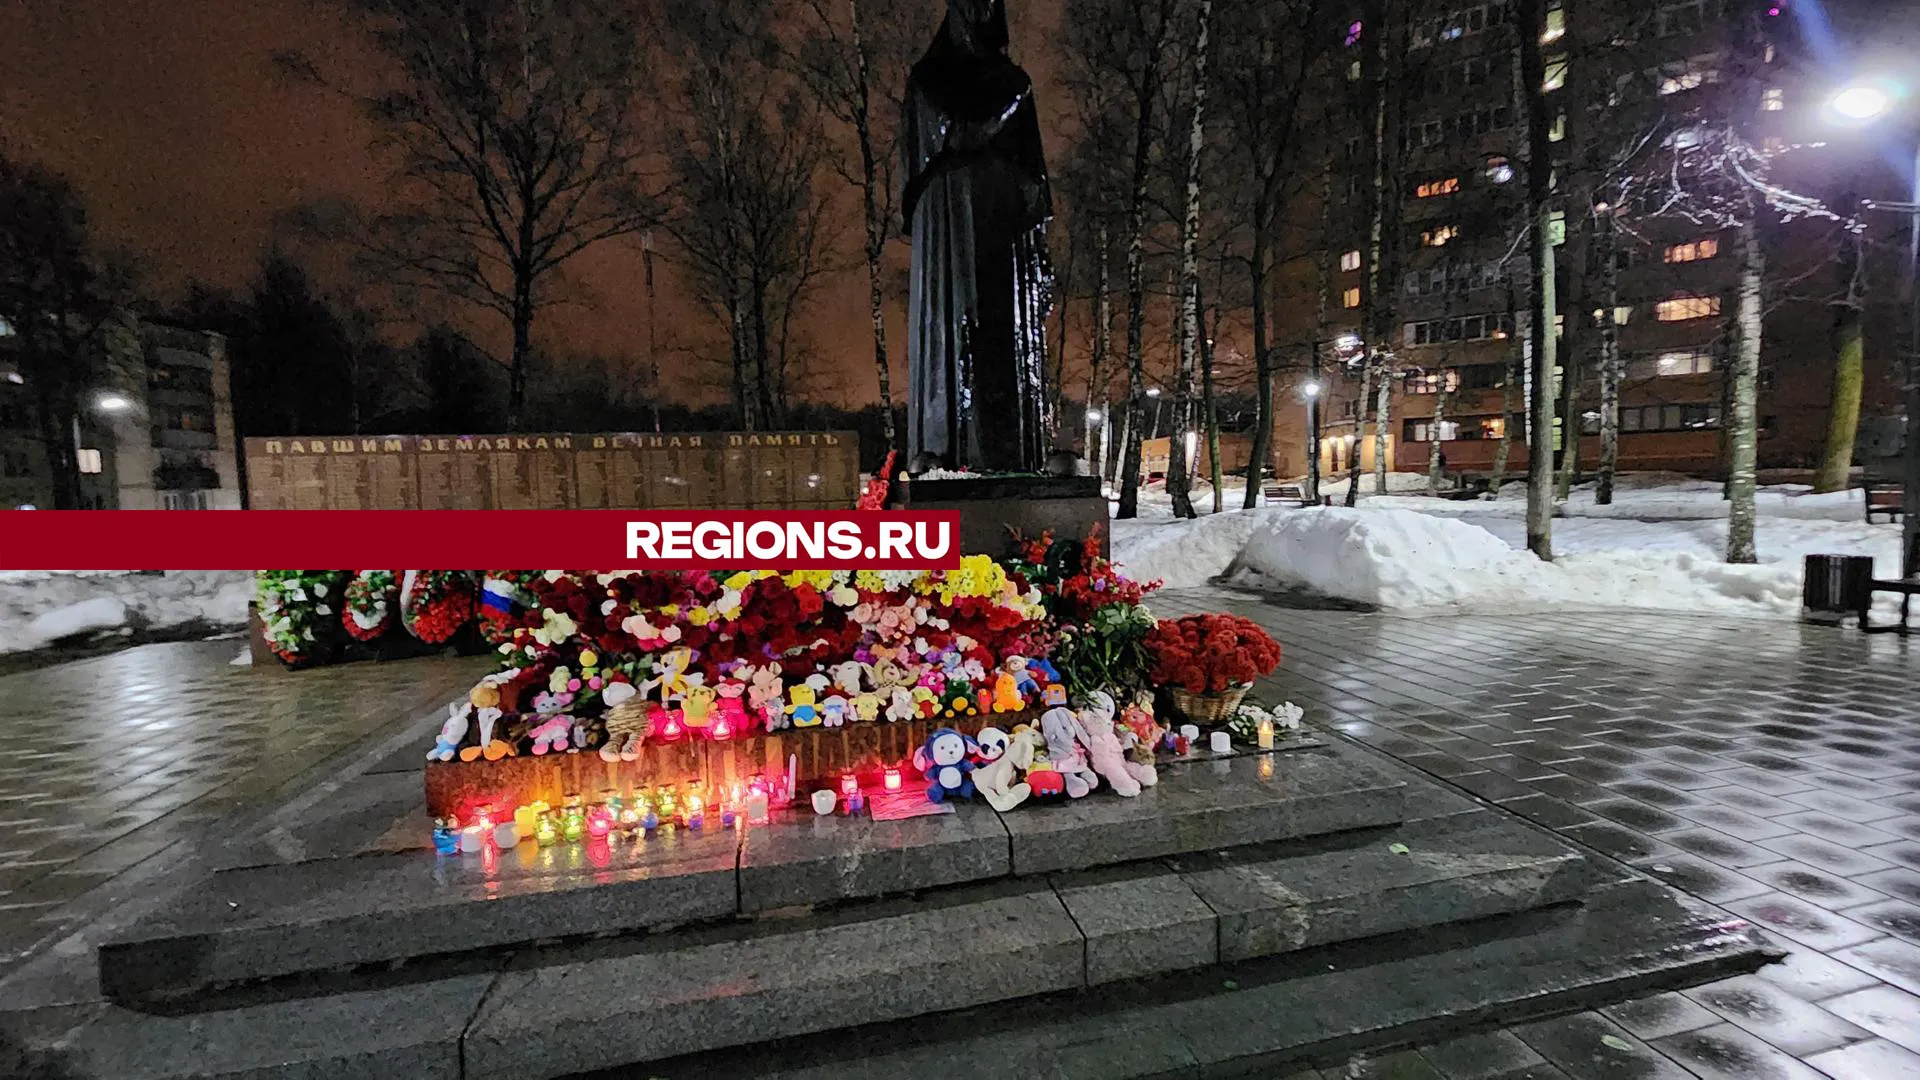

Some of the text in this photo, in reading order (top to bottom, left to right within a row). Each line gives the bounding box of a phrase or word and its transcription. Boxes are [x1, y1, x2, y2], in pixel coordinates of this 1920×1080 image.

[265, 439, 403, 454] ПАВШИМ
[419, 437, 572, 452] ЗЕМЛЯКАМ
[592, 435, 703, 450] ВЕЧНАЯ
